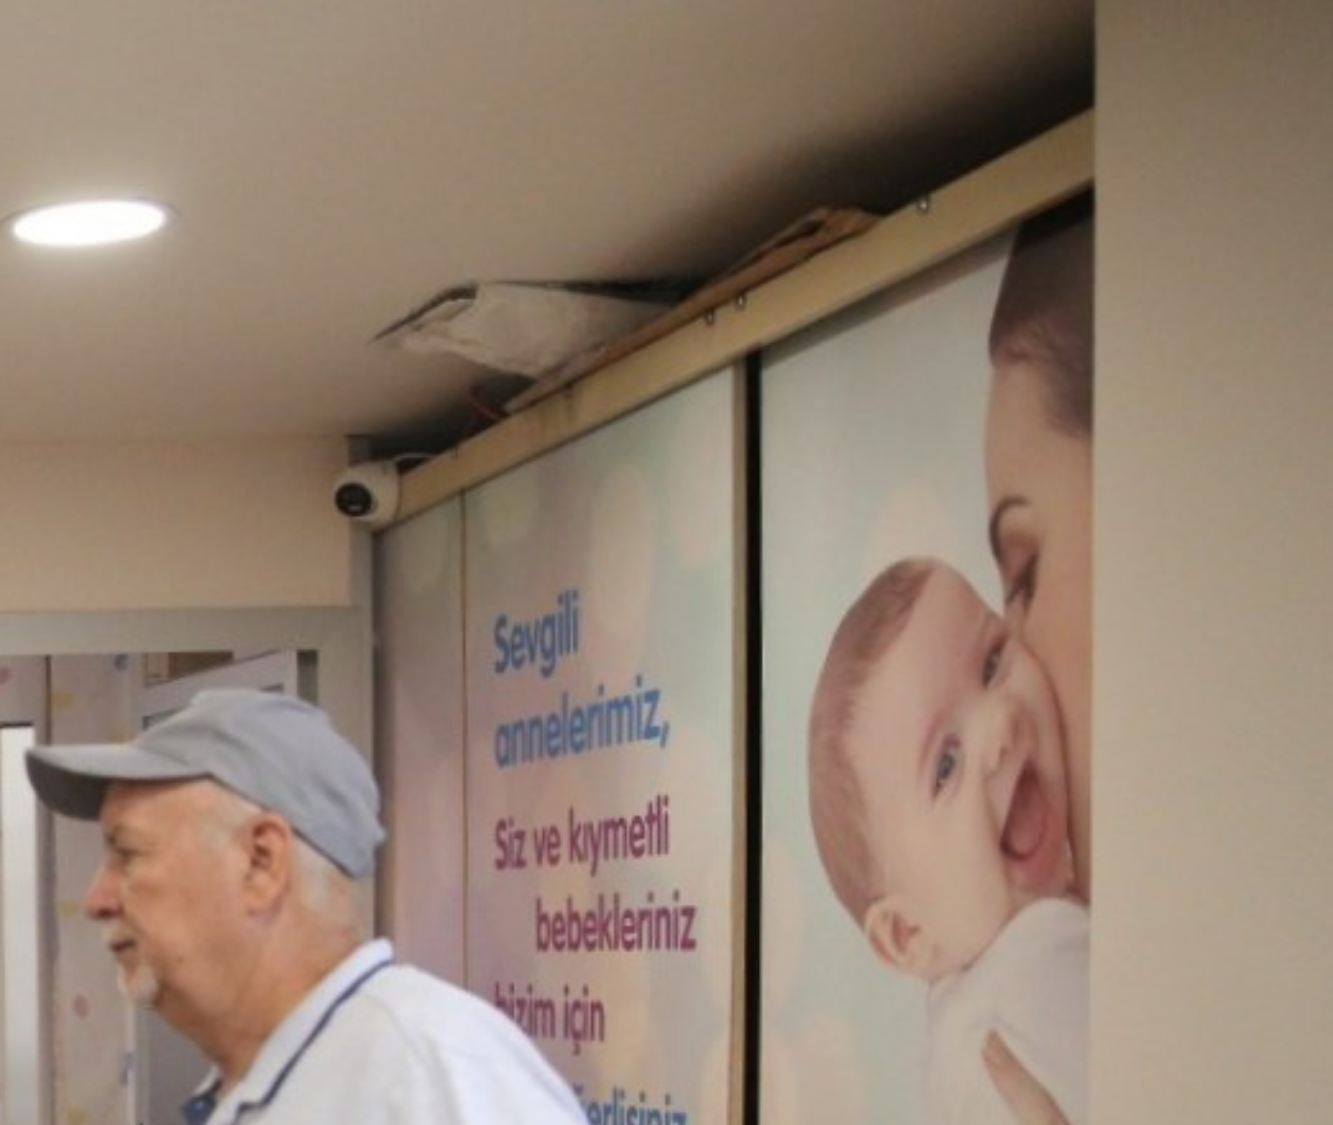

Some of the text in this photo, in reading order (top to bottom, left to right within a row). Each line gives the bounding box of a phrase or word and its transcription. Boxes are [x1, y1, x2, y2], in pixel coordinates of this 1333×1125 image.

[494, 588, 579, 677] Sevgili
[495, 674, 670, 768] annelerimiz,
[495, 795, 670, 877] Siz ve kıymetli
[536, 889, 698, 951] bebekleriniz
[563, 983, 605, 1056] için
